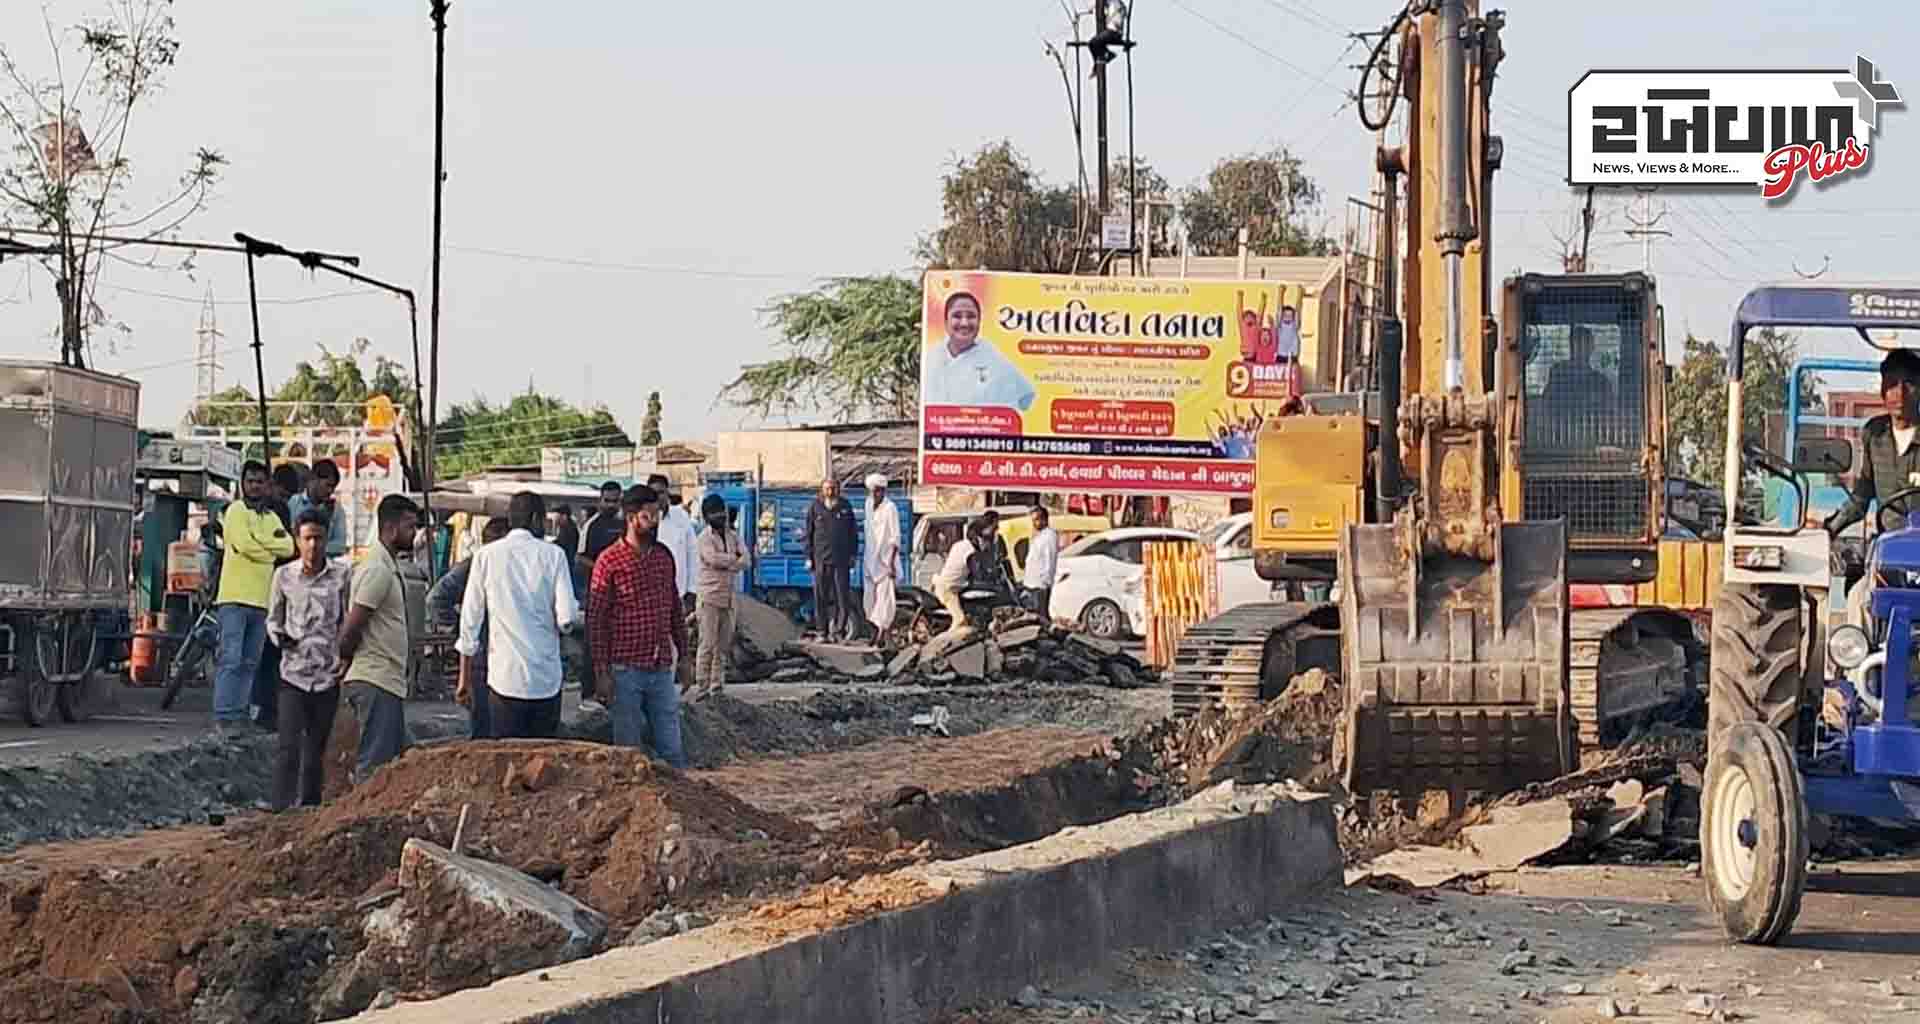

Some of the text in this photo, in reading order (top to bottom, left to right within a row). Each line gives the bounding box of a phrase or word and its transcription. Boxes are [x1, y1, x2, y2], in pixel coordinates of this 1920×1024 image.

[999, 299, 1224, 338] અલવિદા તનાવ
[1230, 365, 1250, 394] 9
